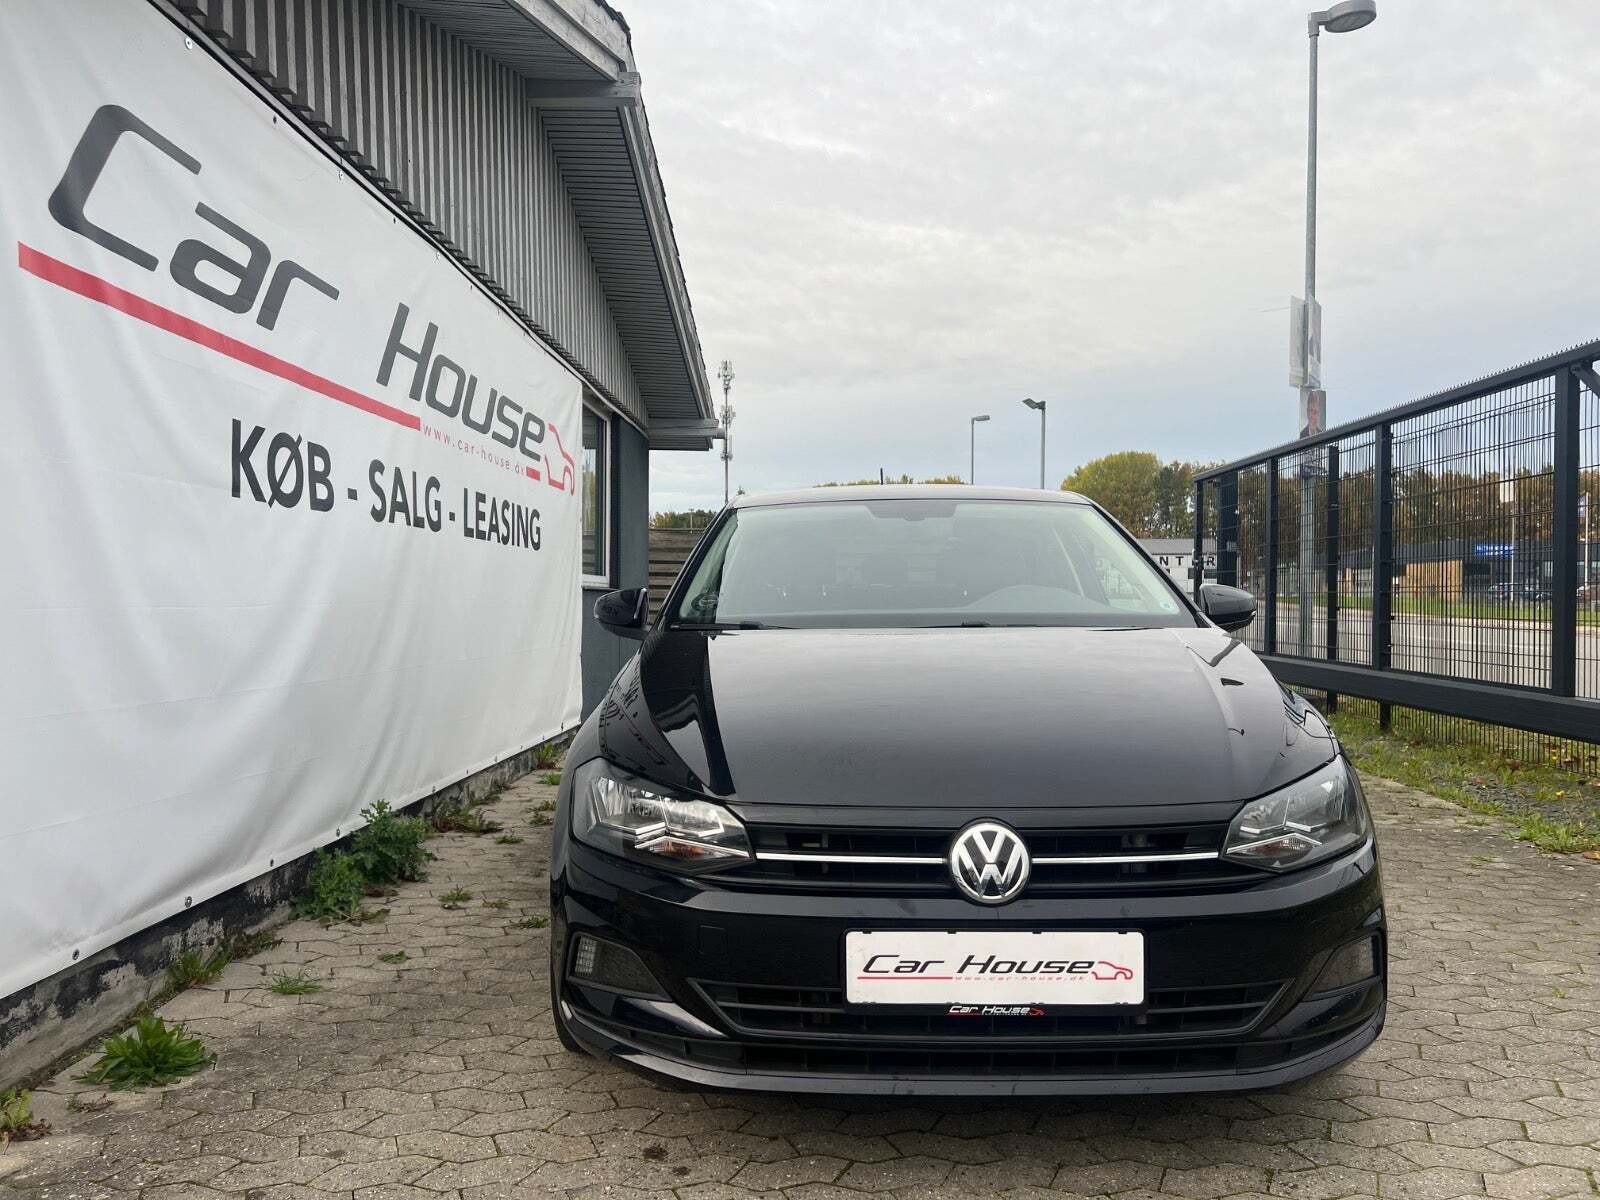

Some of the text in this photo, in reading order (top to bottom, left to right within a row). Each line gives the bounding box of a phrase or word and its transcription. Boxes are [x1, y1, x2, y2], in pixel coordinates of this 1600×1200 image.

[47, 104, 545, 462] Car House
[230, 418, 335, 513] KØB
[347, 487, 358, 501] -
[368, 459, 442, 532] SALG
[463, 487, 541, 551] LEASING
[955, 825, 1026, 897] VW
[862, 954, 1095, 974] Car House
[949, 1005, 1031, 1014] Car House
